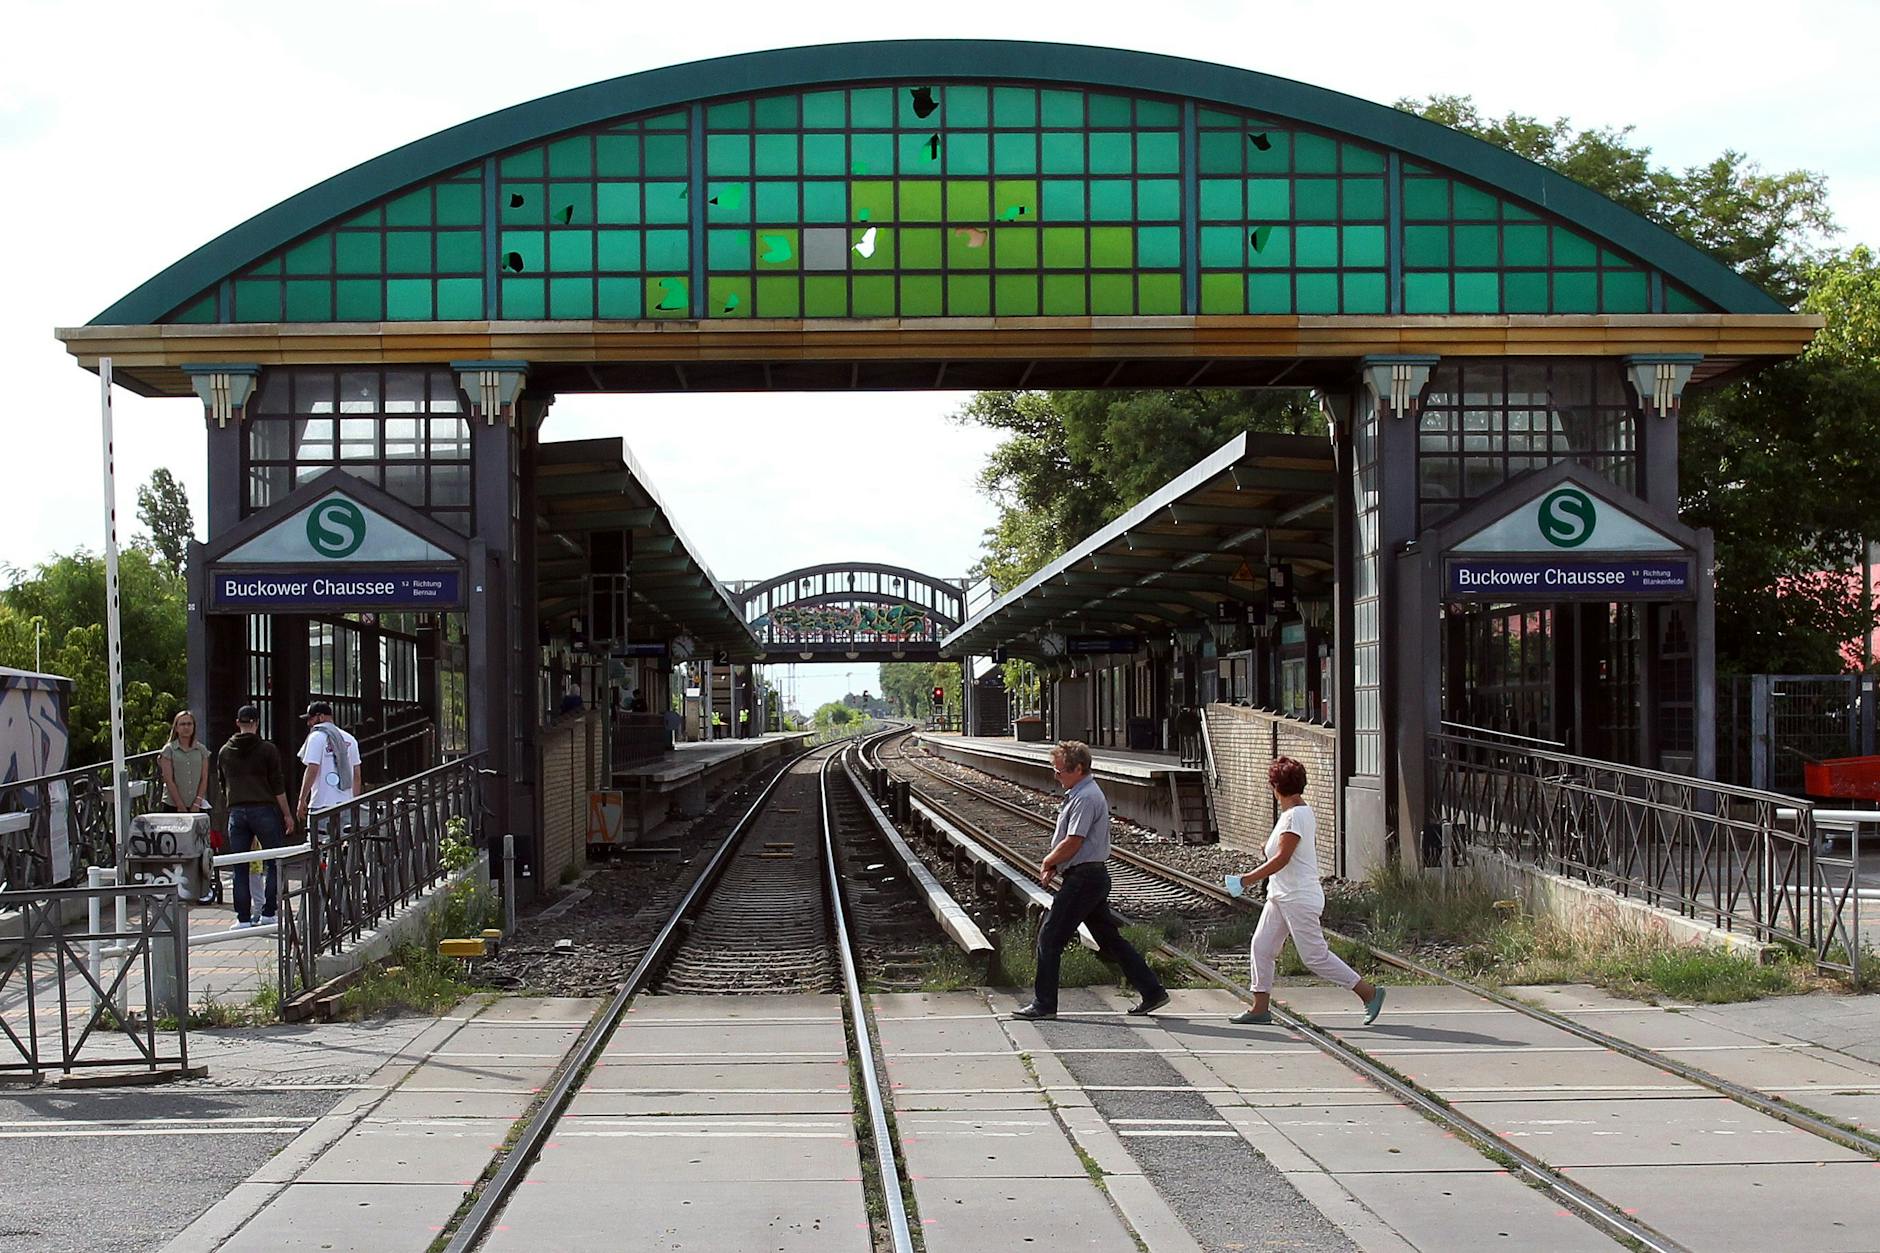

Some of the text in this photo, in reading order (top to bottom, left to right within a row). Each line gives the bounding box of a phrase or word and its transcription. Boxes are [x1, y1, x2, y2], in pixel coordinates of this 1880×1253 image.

[1550, 495, 1585, 541] S
[318, 506, 354, 551] S
[1459, 568, 1625, 585] Buckower Chaussee
[1643, 570, 1671, 578] Richtung
[225, 578, 395, 597] Buckower Chaussee
[413, 580, 442, 589] Richtung
[1643, 578, 1684, 586] Blankenfelde
[413, 588, 436, 597] Bernau
[719, 650, 728, 664] 2
[992, 648, 999, 661] 1
